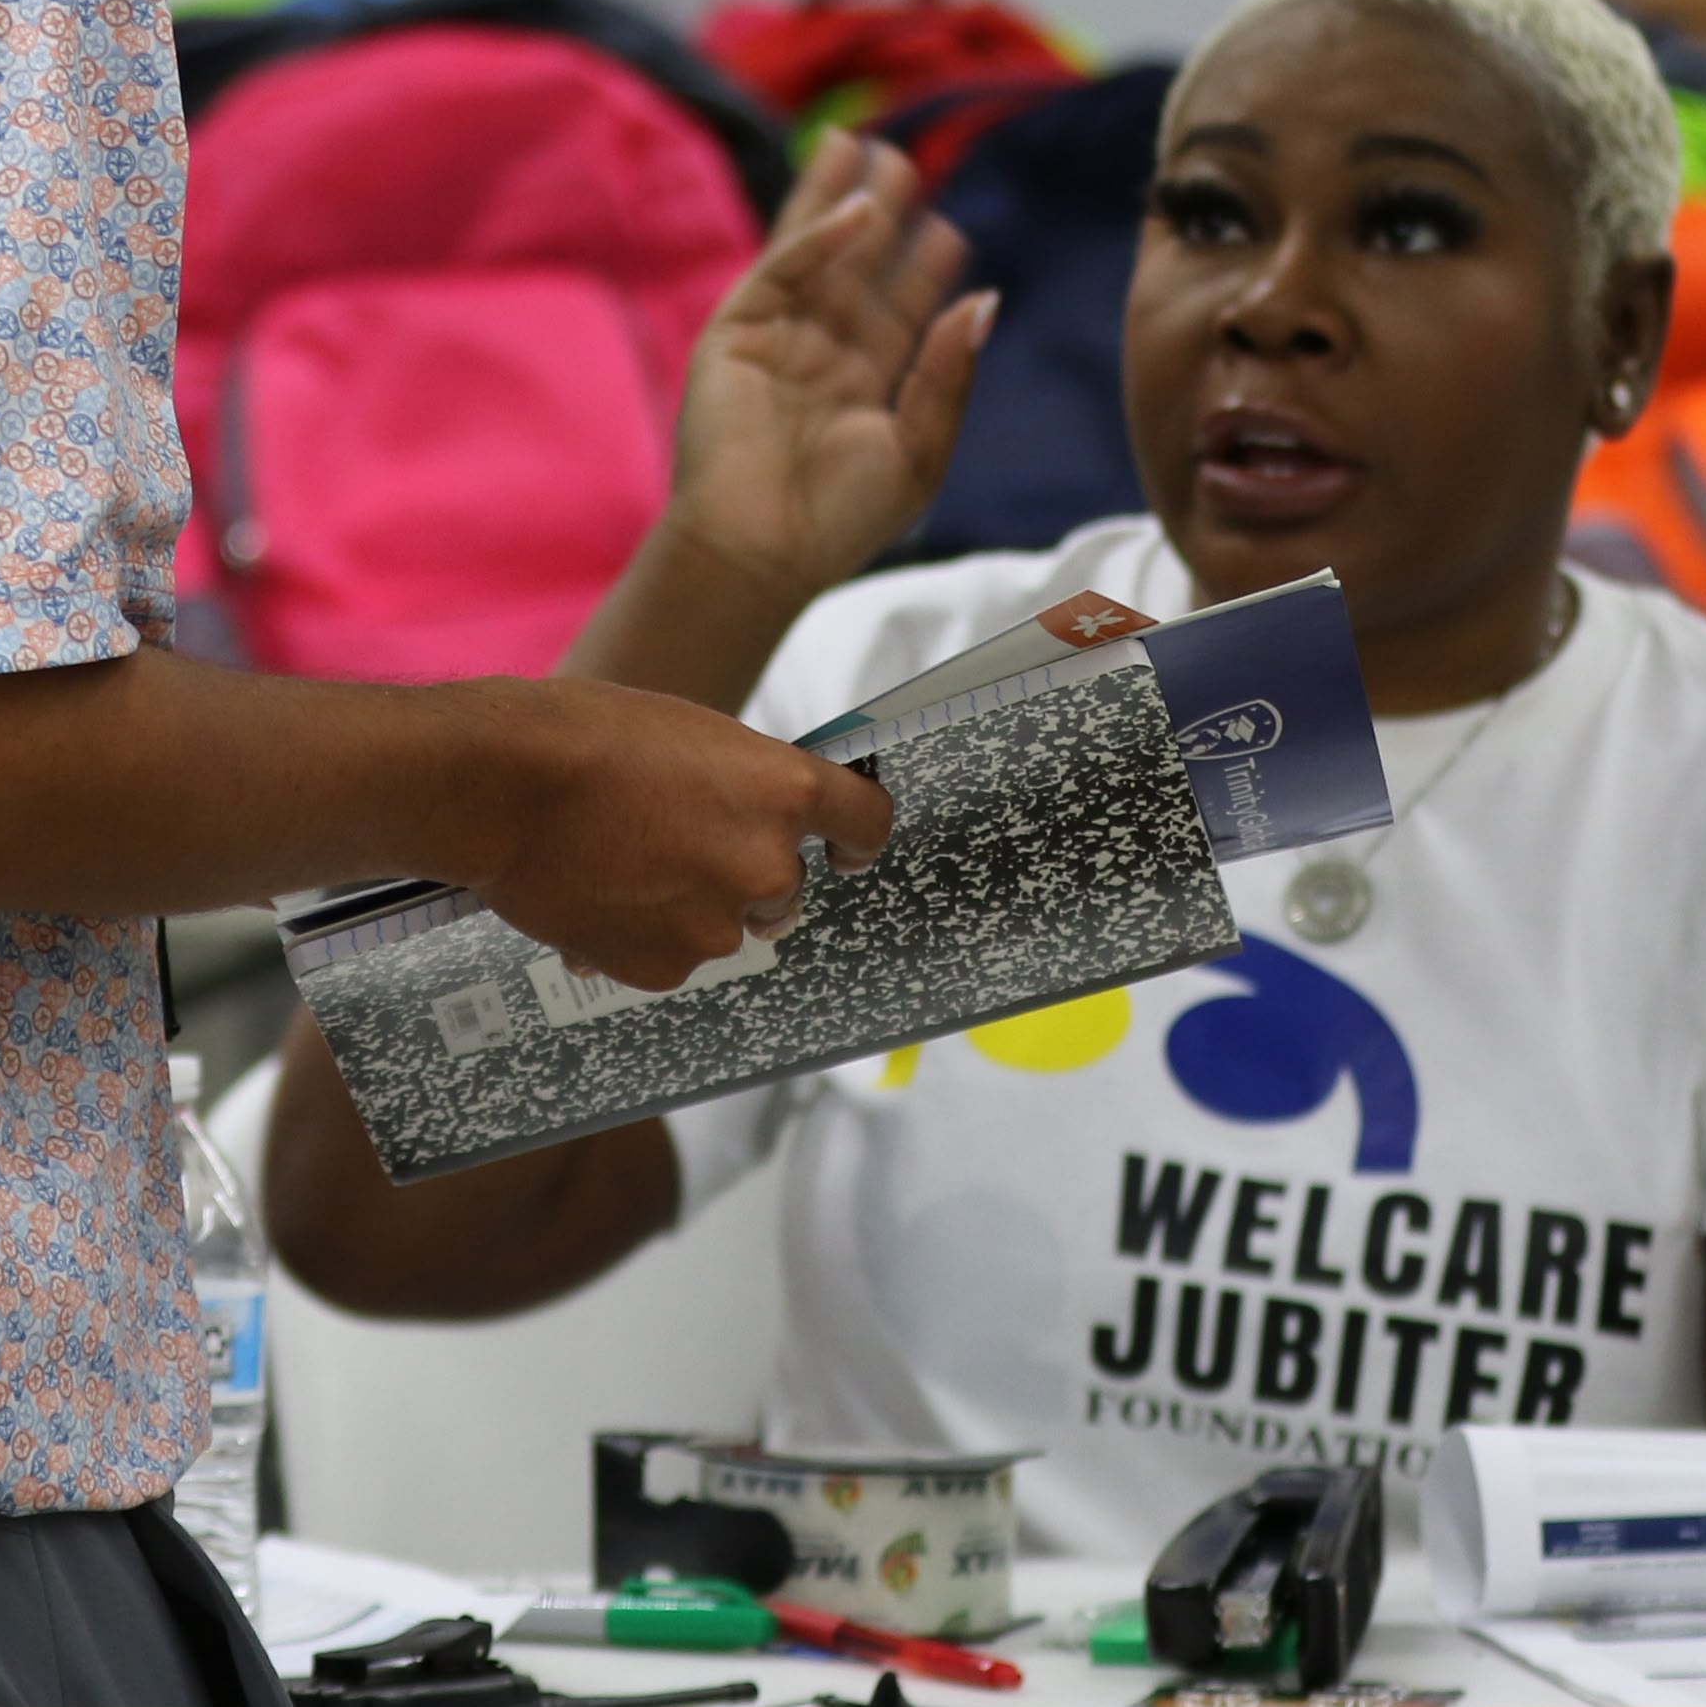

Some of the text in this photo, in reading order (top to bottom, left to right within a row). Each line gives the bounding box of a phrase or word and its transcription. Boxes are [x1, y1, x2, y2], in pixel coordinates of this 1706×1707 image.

[1116, 1151, 1653, 1337] WELCARE
[1090, 1276, 1585, 1427] JUBITER
[1086, 1389, 1433, 1479] FOUNDATIO
